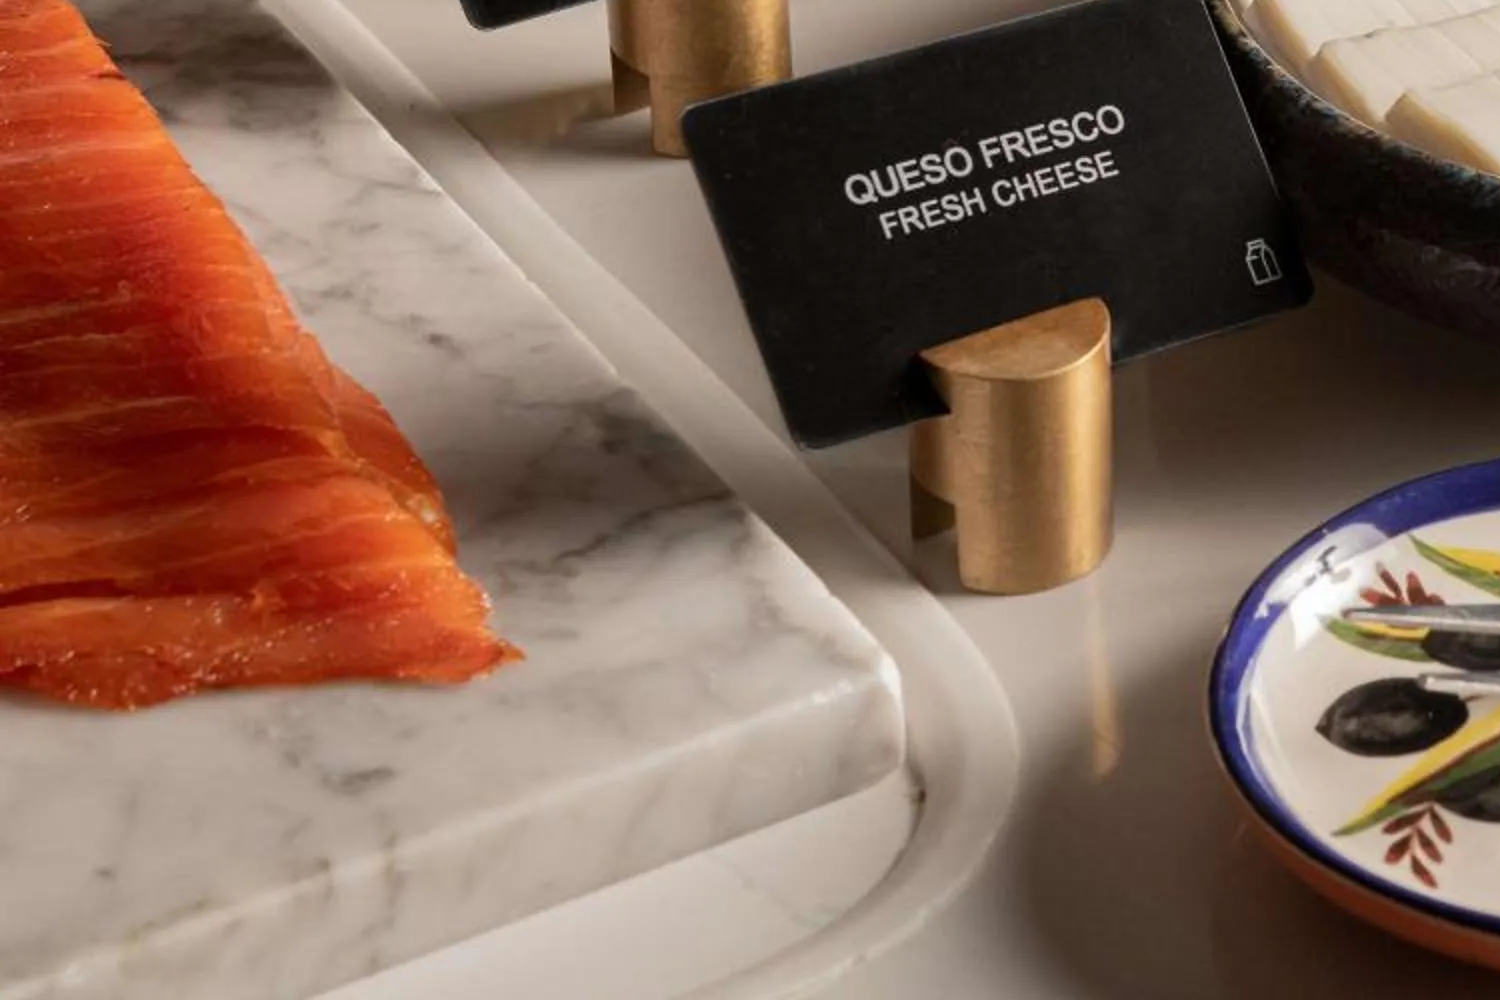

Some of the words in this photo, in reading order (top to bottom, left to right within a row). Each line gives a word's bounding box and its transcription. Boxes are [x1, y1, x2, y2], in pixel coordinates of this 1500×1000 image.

[844, 146, 973, 206] QUESO
[978, 104, 1125, 169] FRESCO
[878, 189, 987, 240] FRESH
[991, 151, 1120, 208] CHEESE
